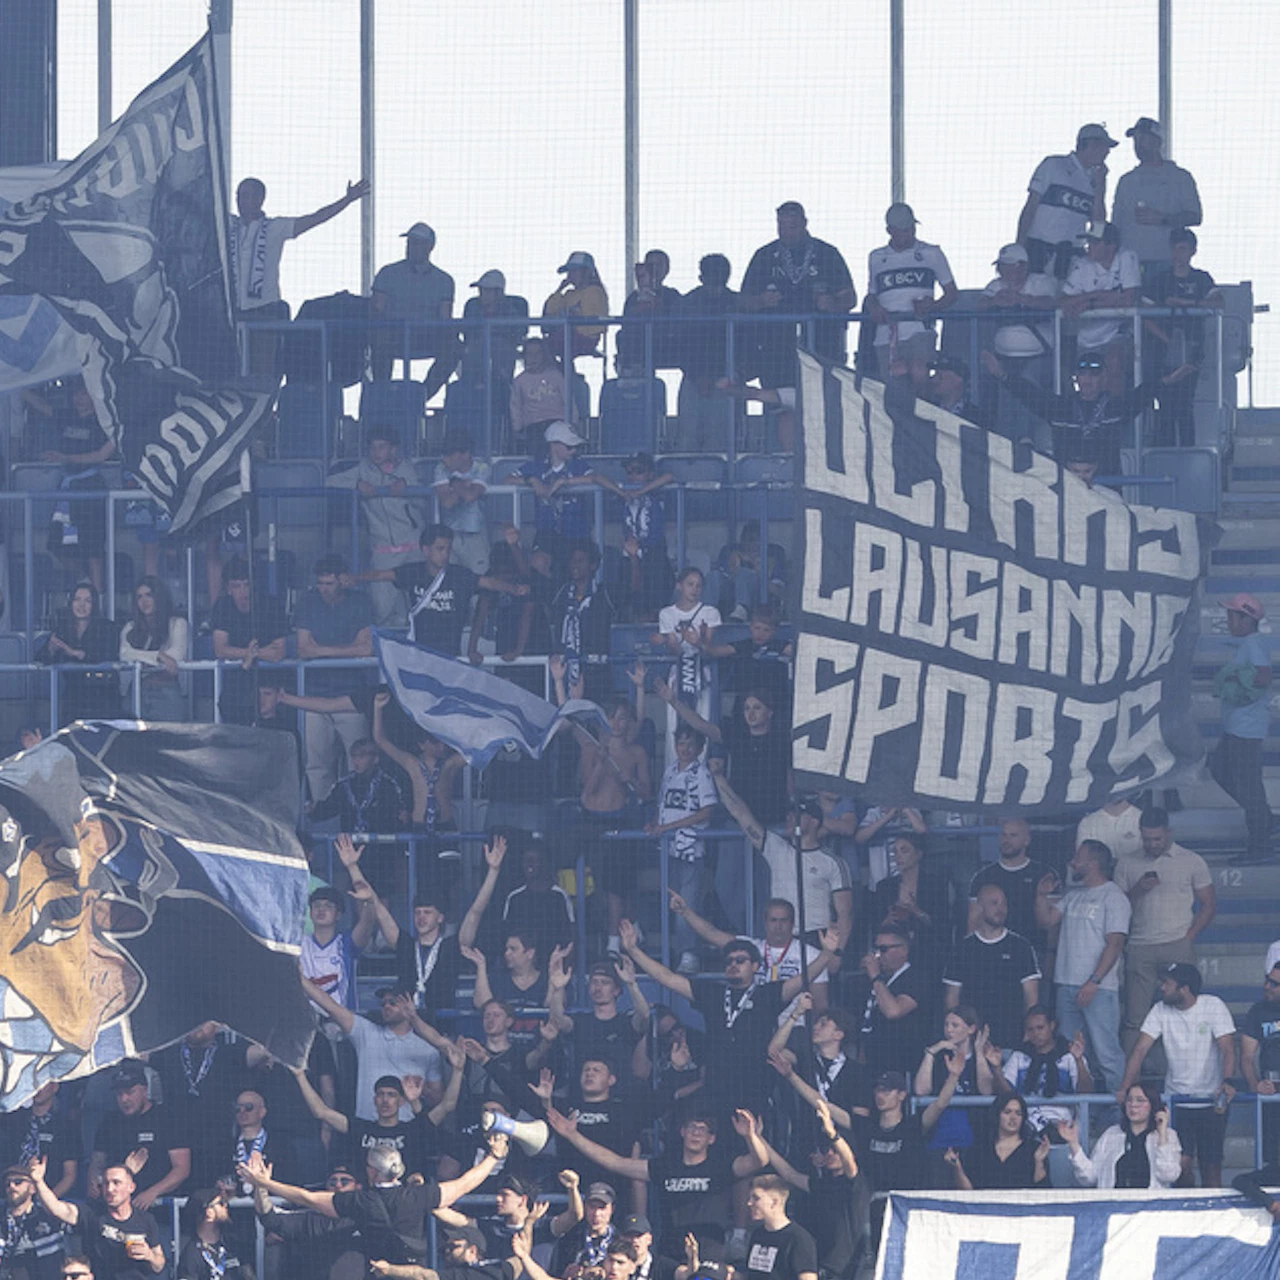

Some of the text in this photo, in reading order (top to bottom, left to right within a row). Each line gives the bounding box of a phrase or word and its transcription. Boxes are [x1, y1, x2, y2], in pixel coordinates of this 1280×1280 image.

[895, 272, 927, 286] BCV
[798, 347, 1200, 582] ULTRAS
[802, 509, 1186, 686] LAUSANNE
[793, 634, 1175, 804] SPORTS
[1219, 868, 1242, 887] 12
